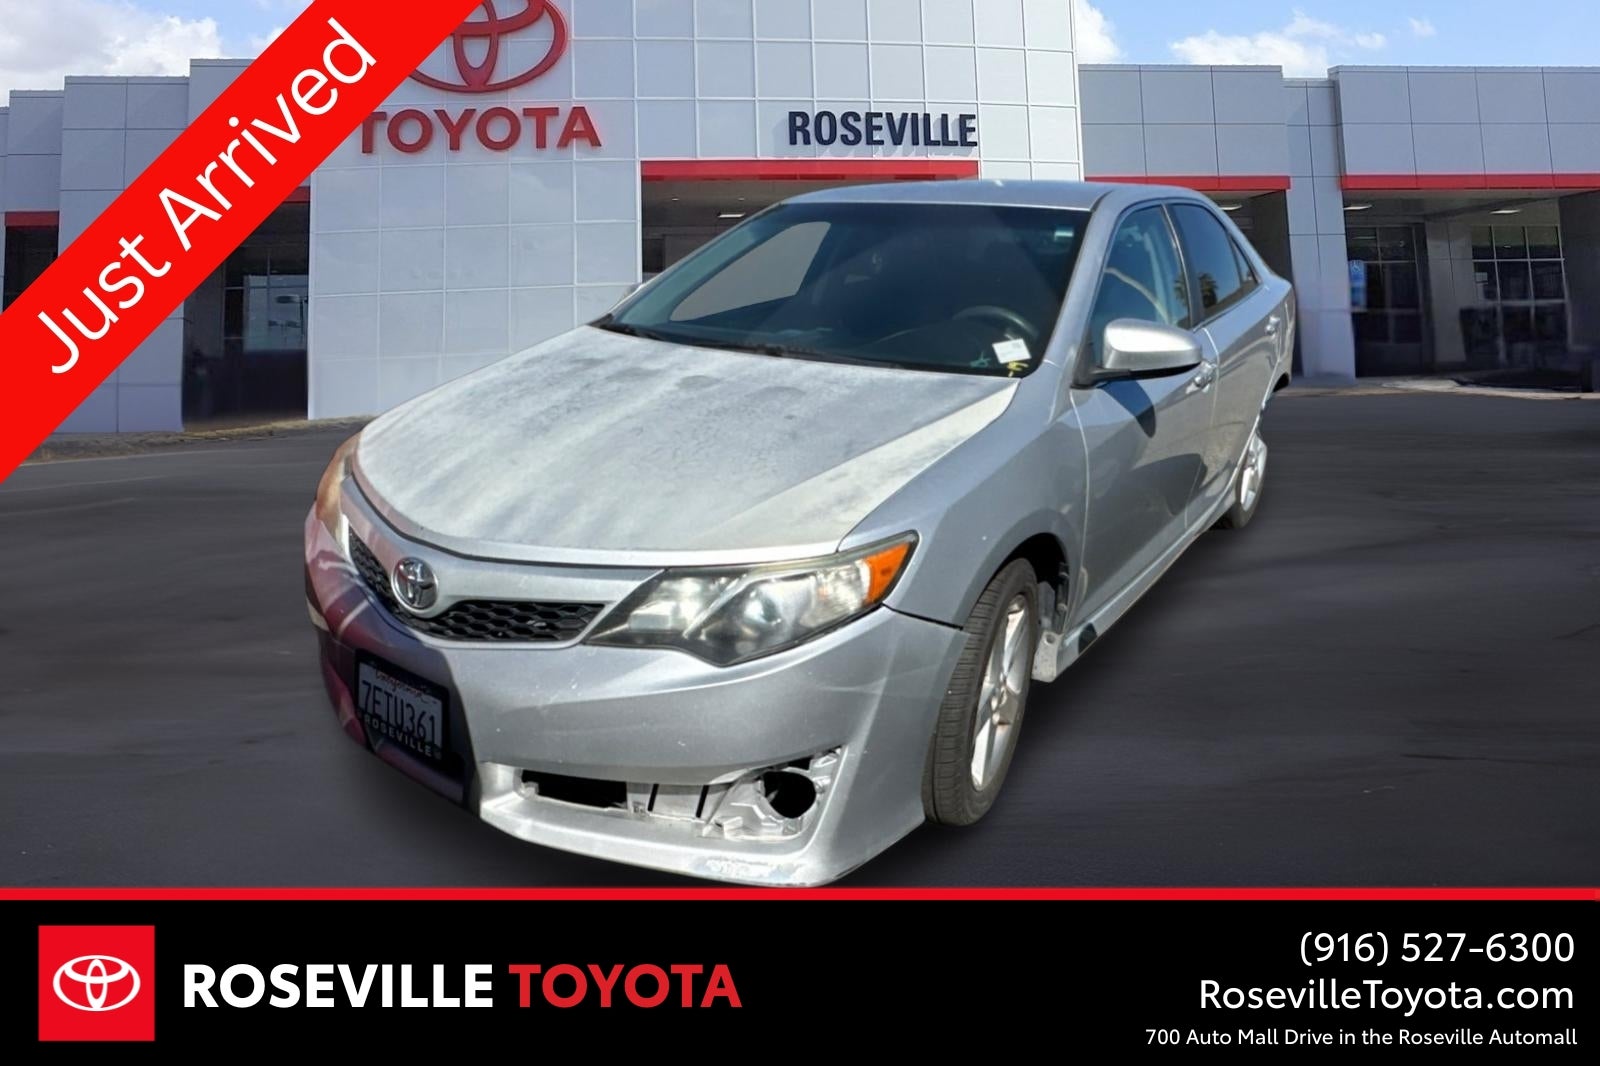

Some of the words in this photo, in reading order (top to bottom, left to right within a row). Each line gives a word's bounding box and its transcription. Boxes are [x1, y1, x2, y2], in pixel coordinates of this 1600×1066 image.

[361, 106, 602, 154] TOYOTA
[788, 110, 978, 148] ROSEVILLE
[362, 680, 436, 749] 7ETU361
[364, 713, 433, 758] ROSEVILLE
